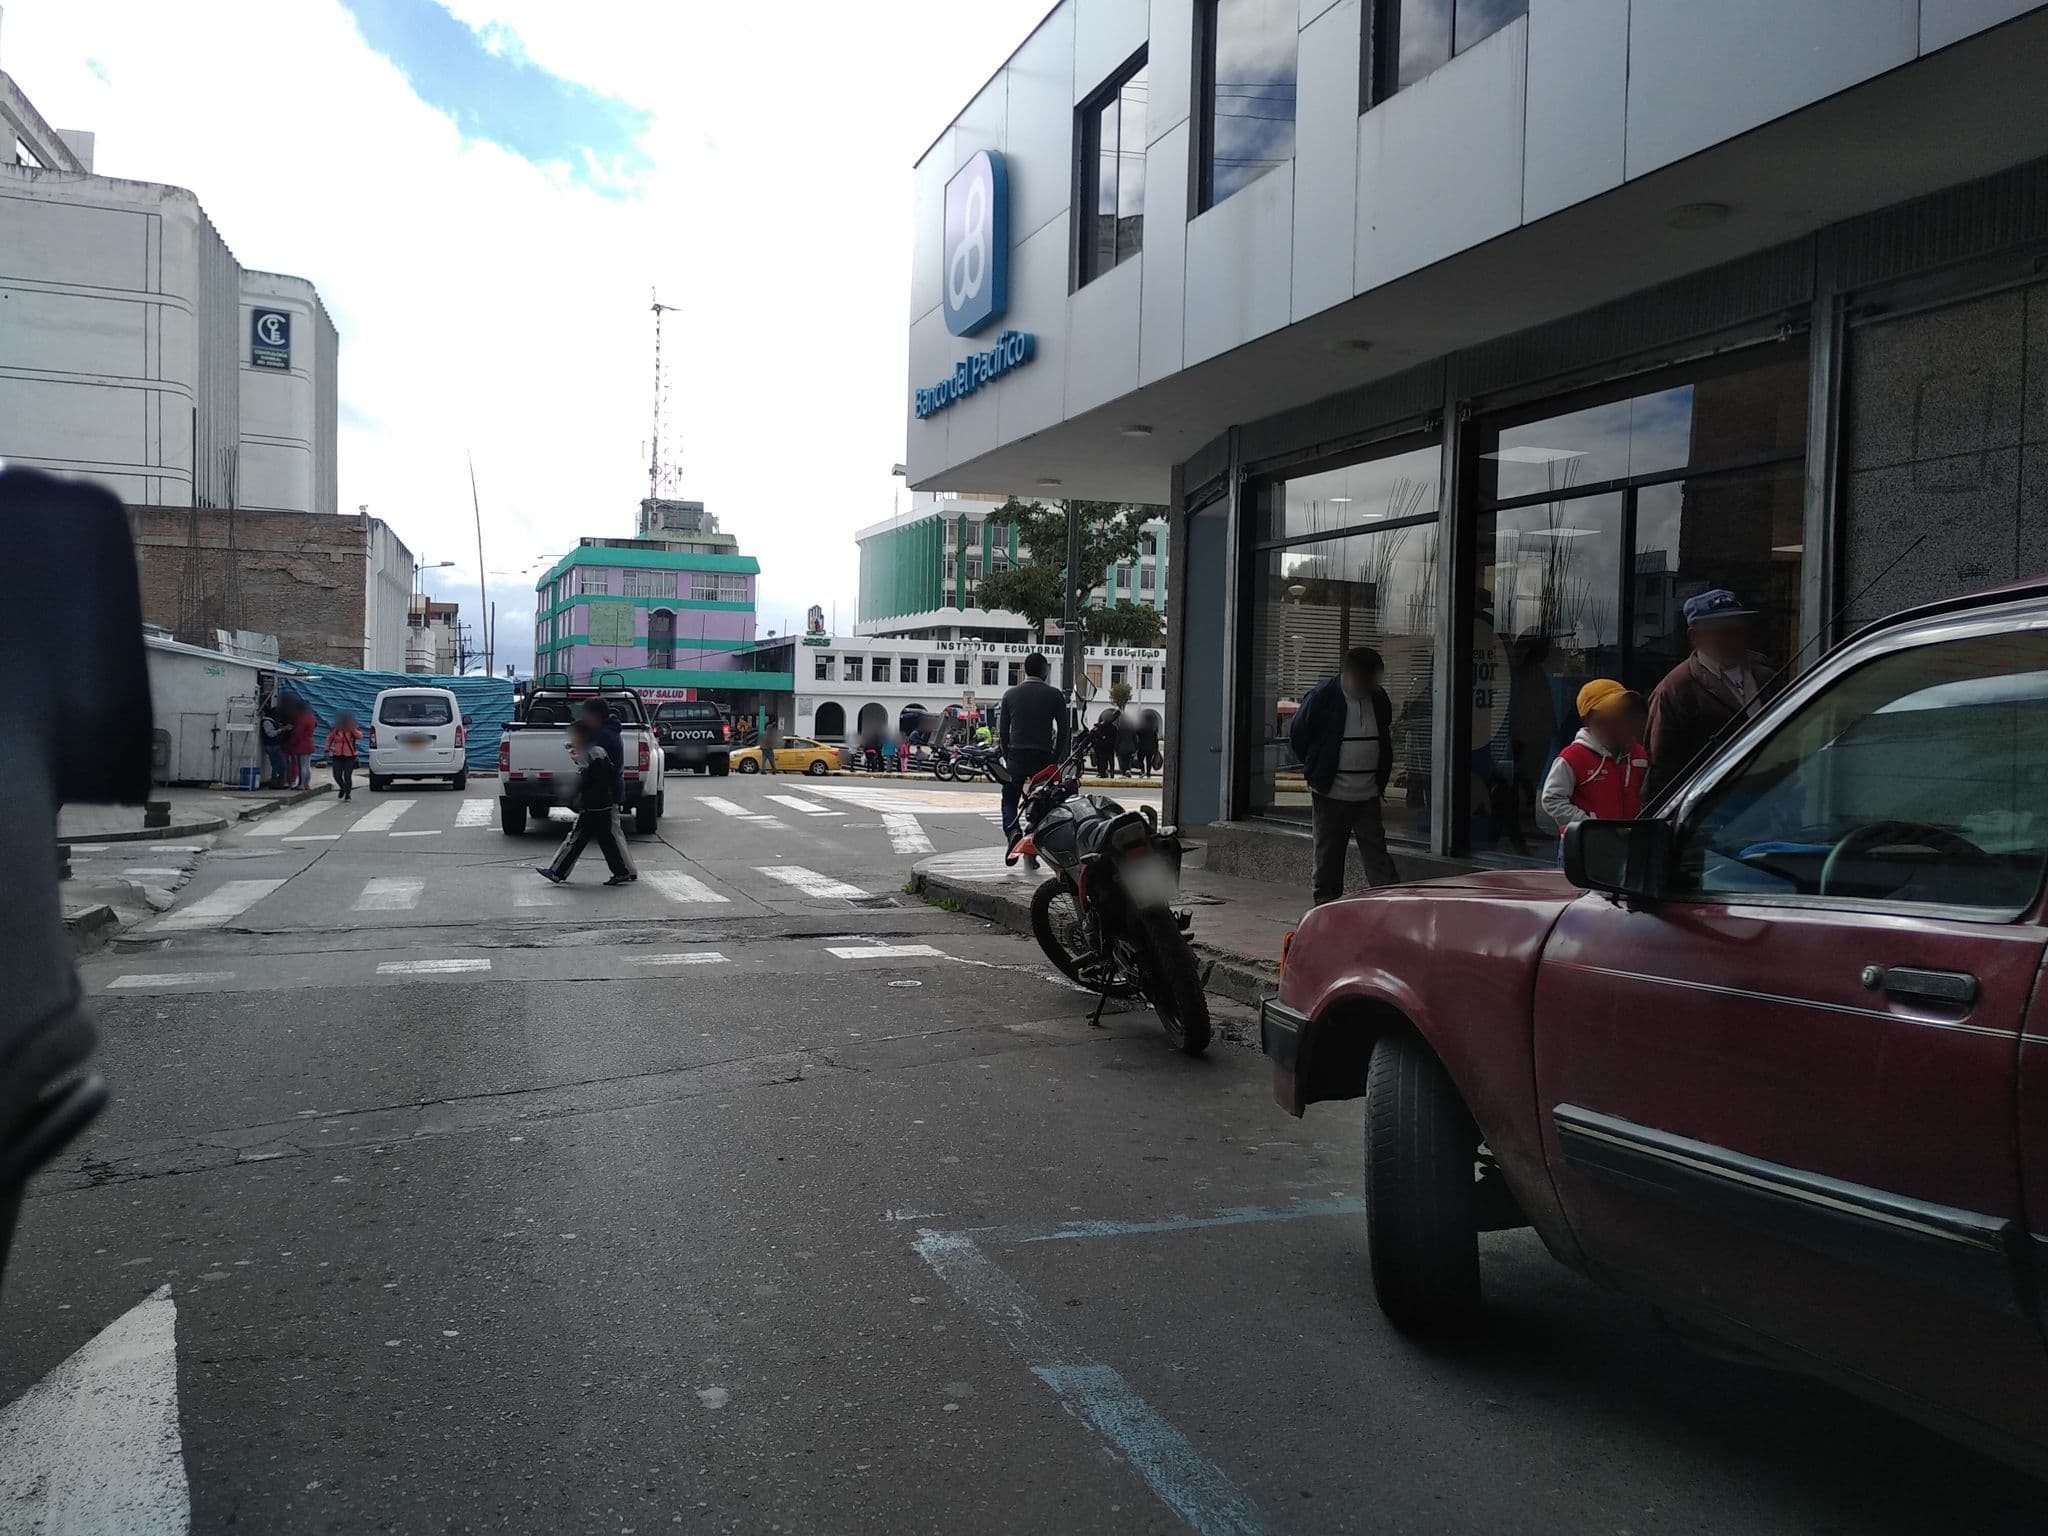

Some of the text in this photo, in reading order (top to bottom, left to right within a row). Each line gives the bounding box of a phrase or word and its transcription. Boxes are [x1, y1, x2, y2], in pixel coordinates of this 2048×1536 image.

[914, 377, 949, 420] Banco
[949, 361, 970, 398] del
[656, 690, 684, 698] SALUD
[671, 730, 715, 739] TOYOTA
